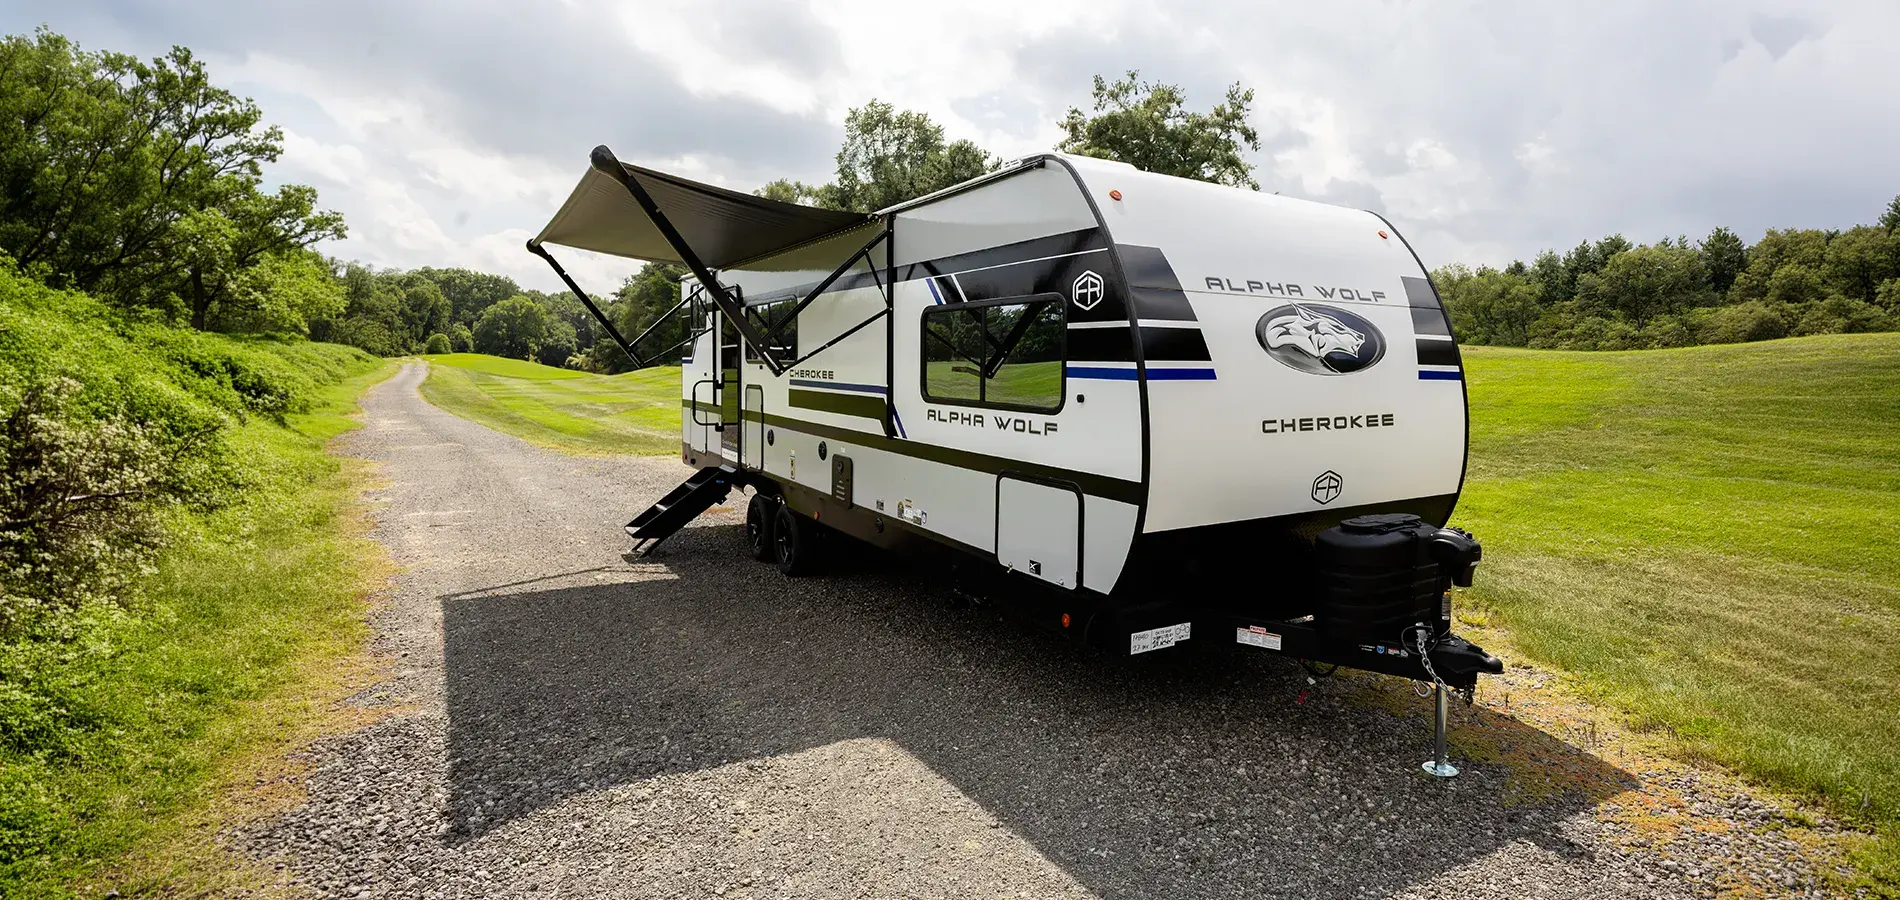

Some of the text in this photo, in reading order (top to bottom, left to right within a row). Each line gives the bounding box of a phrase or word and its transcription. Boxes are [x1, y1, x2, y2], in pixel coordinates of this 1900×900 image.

[1205, 276, 1386, 302] ALPHA WOLF
[789, 369, 834, 380] CHEROKEE
[927, 409, 1058, 436] ALPHA WOLF
[1262, 413, 1394, 434] CHEROKEE
